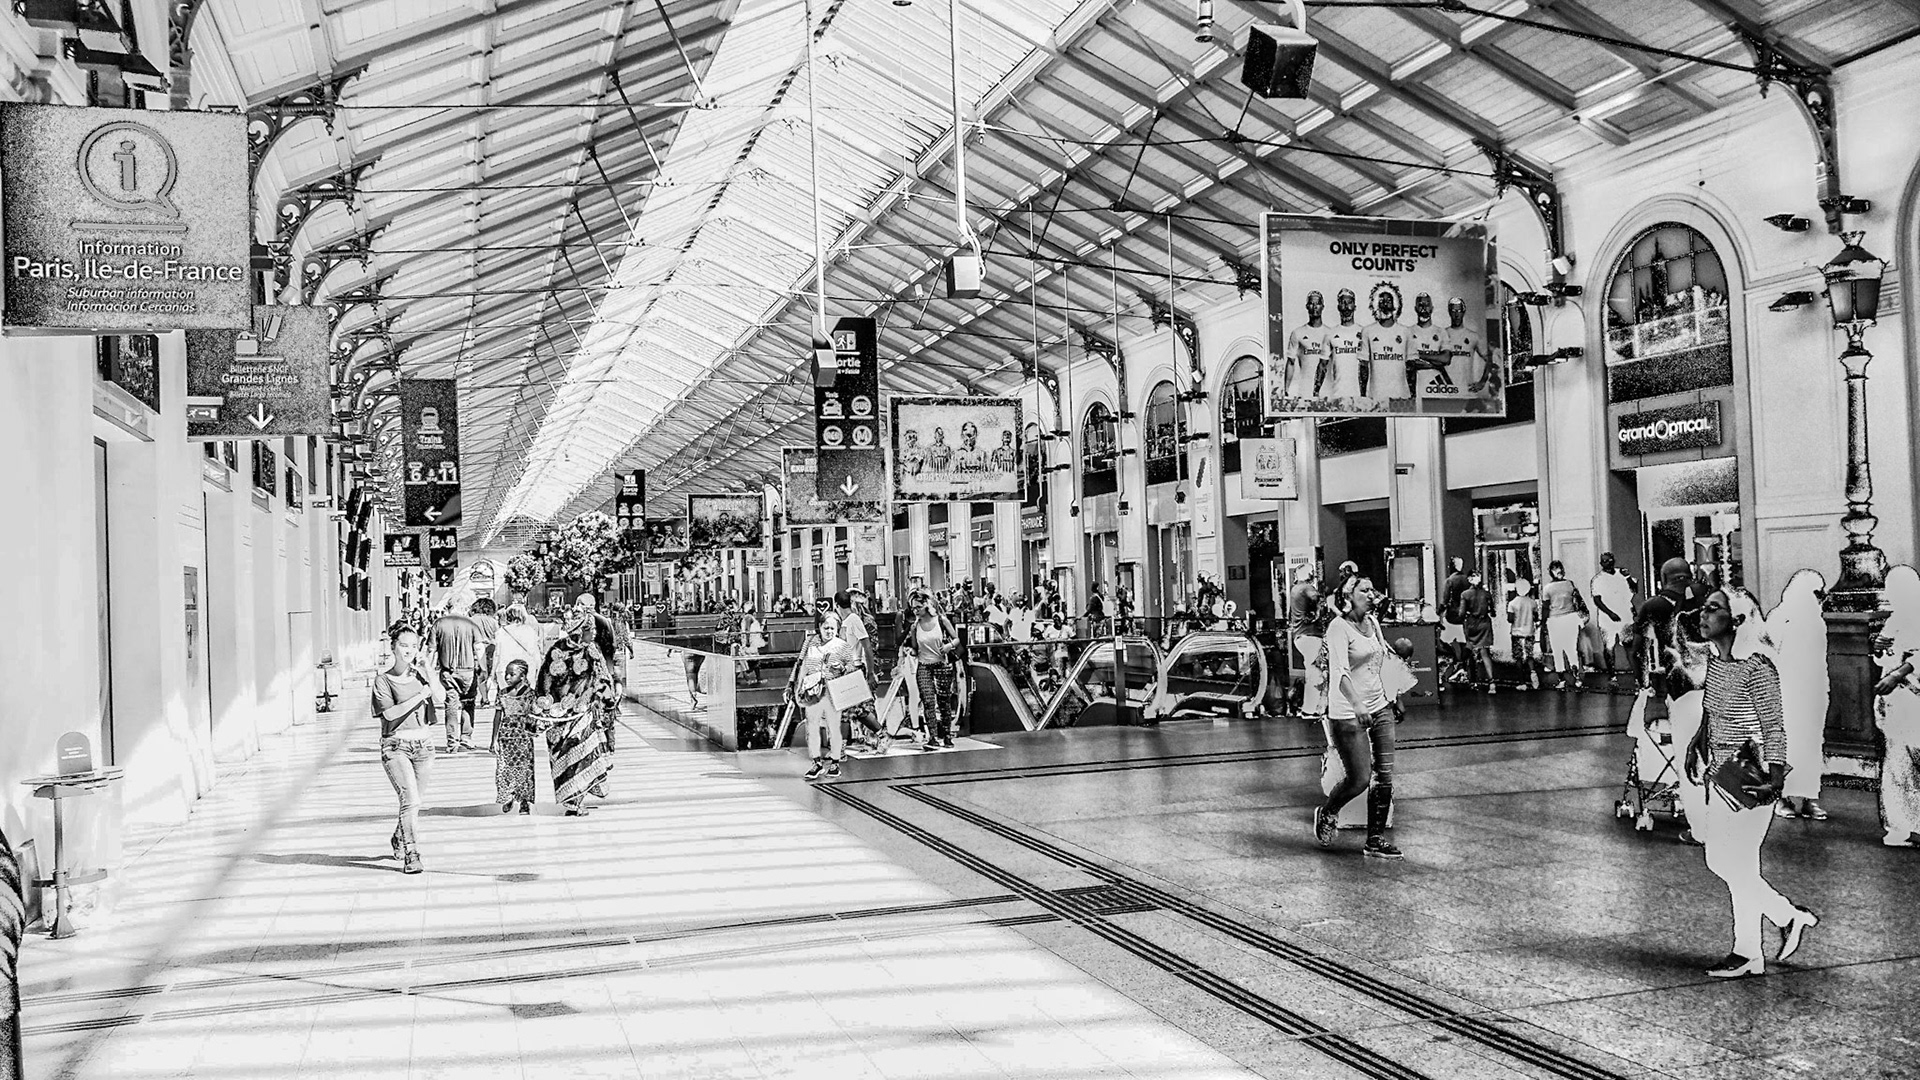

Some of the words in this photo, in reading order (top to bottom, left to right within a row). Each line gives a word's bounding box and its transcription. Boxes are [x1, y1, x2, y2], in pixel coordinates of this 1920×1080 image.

[78, 240, 181, 256] Information
[1329, 241, 1369, 256] ONLY
[1372, 243, 1439, 259] PERFECT
[14, 256, 80, 281] Paris,
[84, 259, 242, 280] Ile-de-France
[67, 287, 124, 299] Suburban
[127, 287, 195, 299] information
[67, 300, 137, 312] Información
[1383, 346, 1393, 354] Fly
[837, 357, 861, 368] ortie
[1373, 352, 1404, 361] Emirates
[268, 364, 290, 373] SNCF
[221, 373, 264, 384] Grandes
[266, 373, 299, 386] Lignes
[1425, 384, 1460, 394] adidas
[854, 401, 869, 411] BUS
[411, 468, 422, 481] 6
[439, 467, 457, 481] 11
